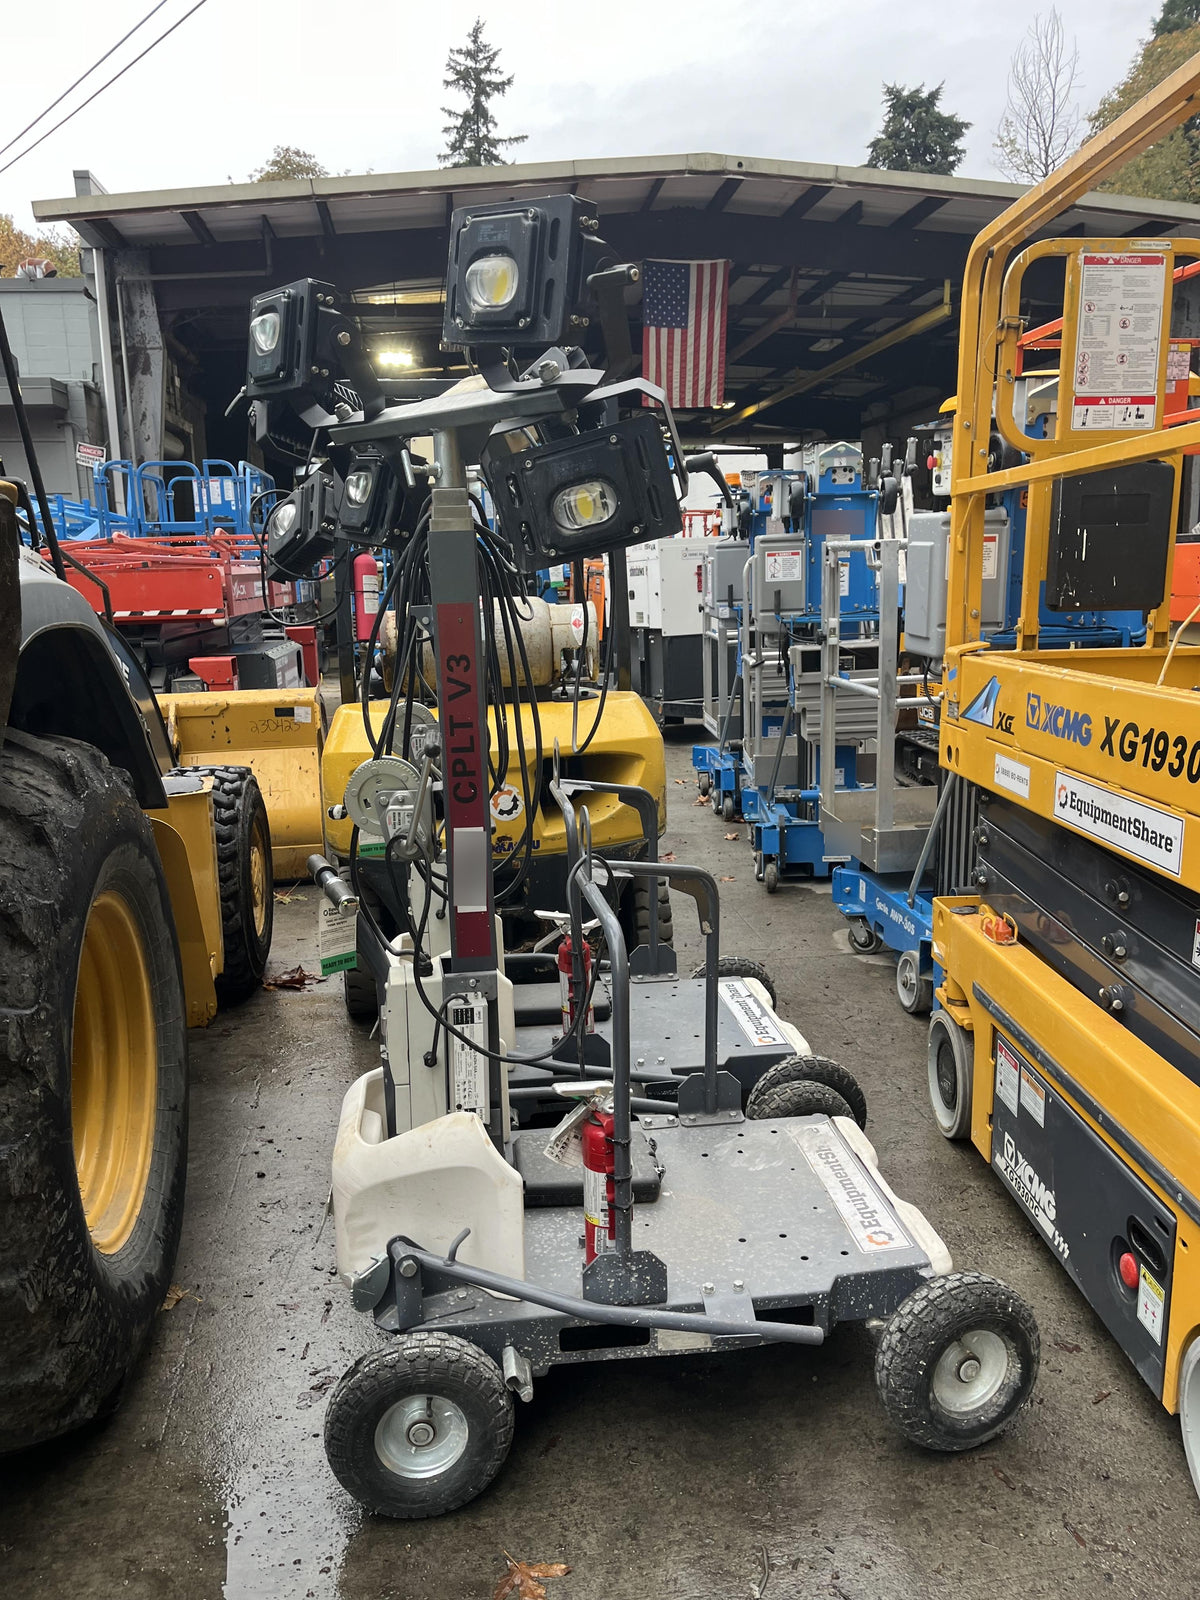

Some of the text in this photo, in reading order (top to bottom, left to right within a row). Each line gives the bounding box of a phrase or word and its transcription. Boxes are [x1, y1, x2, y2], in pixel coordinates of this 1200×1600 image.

[446, 654, 478, 804] CPLT V3
[920, 706, 934, 719] JCB
[996, 711, 1015, 736] XG
[1041, 701, 1092, 747] XCMG
[1100, 716, 1200, 784] XG1930
[1069, 791, 1173, 853] EquipmentShare
[322, 961, 337, 970] READY
[344, 956, 355, 964] RENT
[1003, 1162, 1040, 1218] XG1930DC
[1014, 1150, 1056, 1221] XCMG
